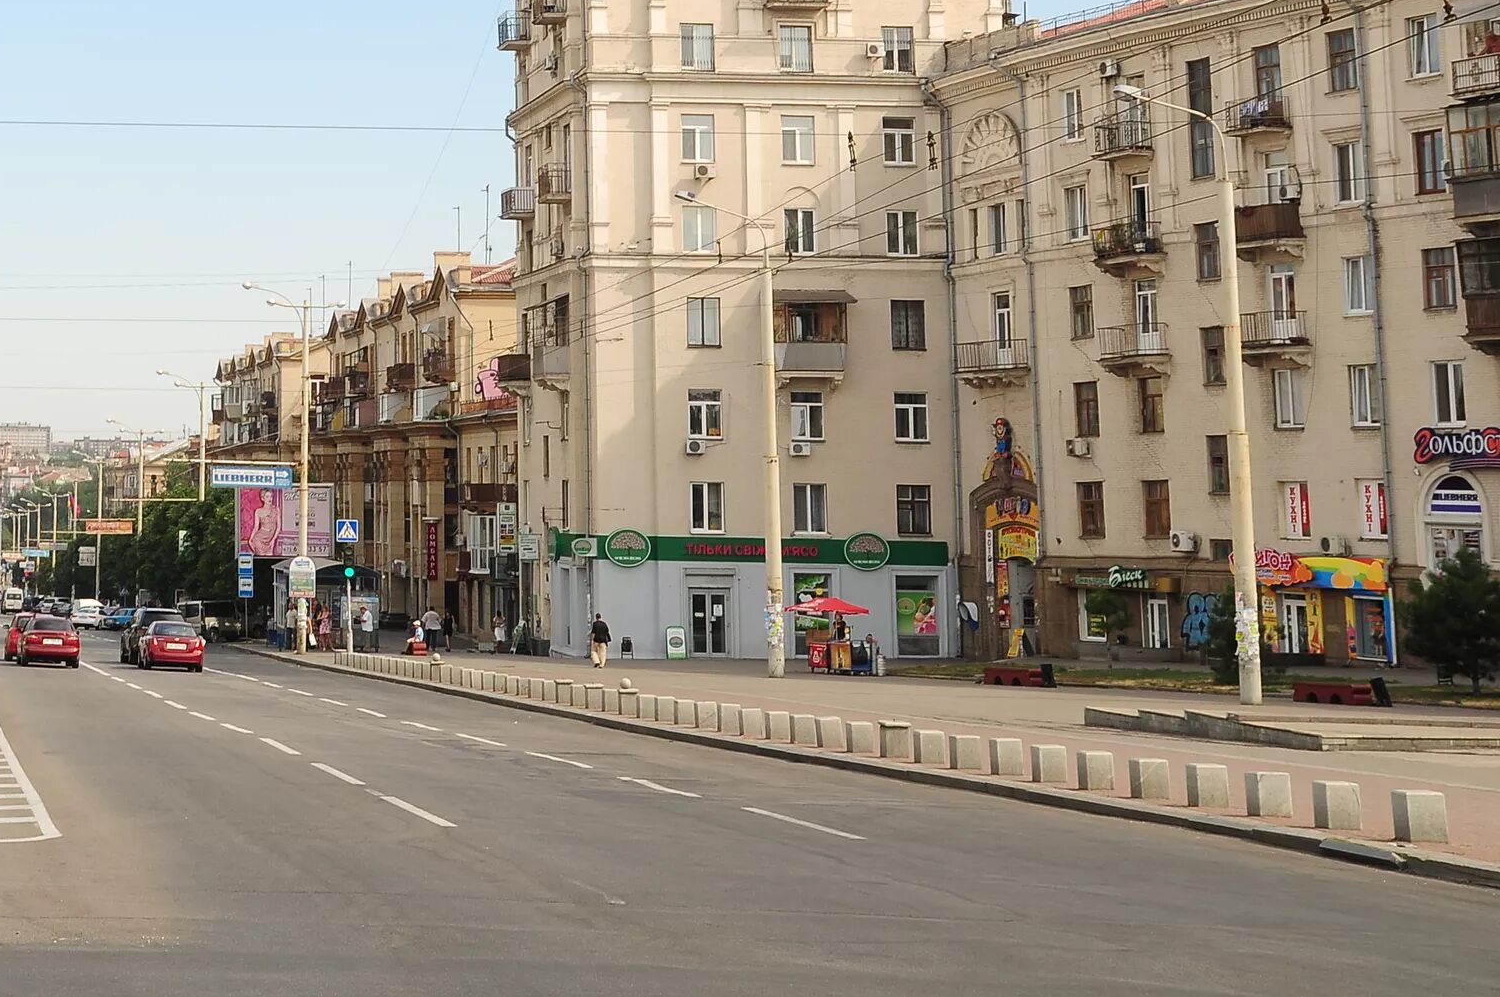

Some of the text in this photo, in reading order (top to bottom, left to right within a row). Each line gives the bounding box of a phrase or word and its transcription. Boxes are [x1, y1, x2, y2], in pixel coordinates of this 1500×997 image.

[214, 474, 273, 483] LIEBHERR
[1438, 493, 1479, 501] LIEBHERR
[1289, 487, 1298, 532] КУХНІ
[1364, 485, 1373, 532] КУХНІ
[685, 543, 732, 556] ТІЛЬКИ
[735, 544, 767, 557] СВІЖ
